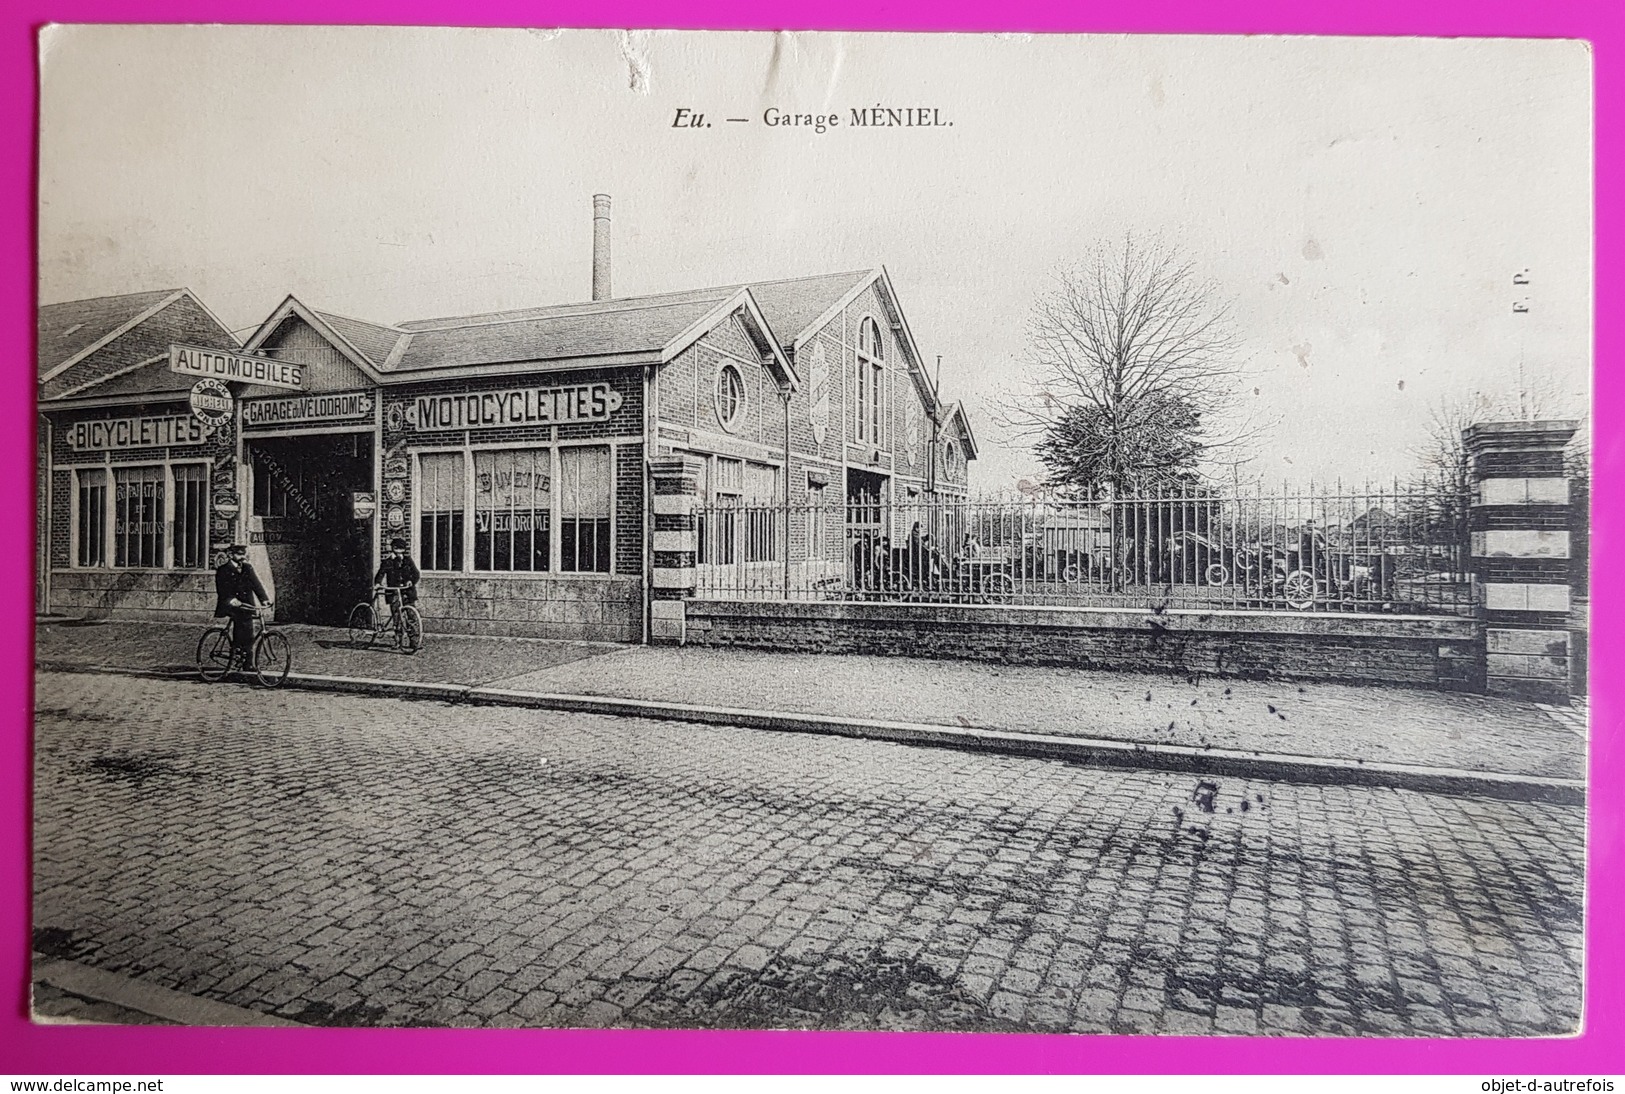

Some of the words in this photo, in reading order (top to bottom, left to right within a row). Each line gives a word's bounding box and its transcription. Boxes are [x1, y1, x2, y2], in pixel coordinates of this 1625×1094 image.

[671, 108, 712, 128] Eu.
[763, 107, 840, 134] Garage
[850, 103, 954, 127] MÉNIEL.
[1512, 269, 1529, 285] P.
[1512, 297, 1529, 314] F.
[177, 349, 302, 386] AUTOMOBILES
[196, 380, 228, 396] STOCK
[250, 401, 293, 421] GARAGE
[418, 384, 607, 428] MOTOCYCLETTES
[197, 411, 229, 425] PNEUS
[76, 416, 201, 448] BICYCLETTES
